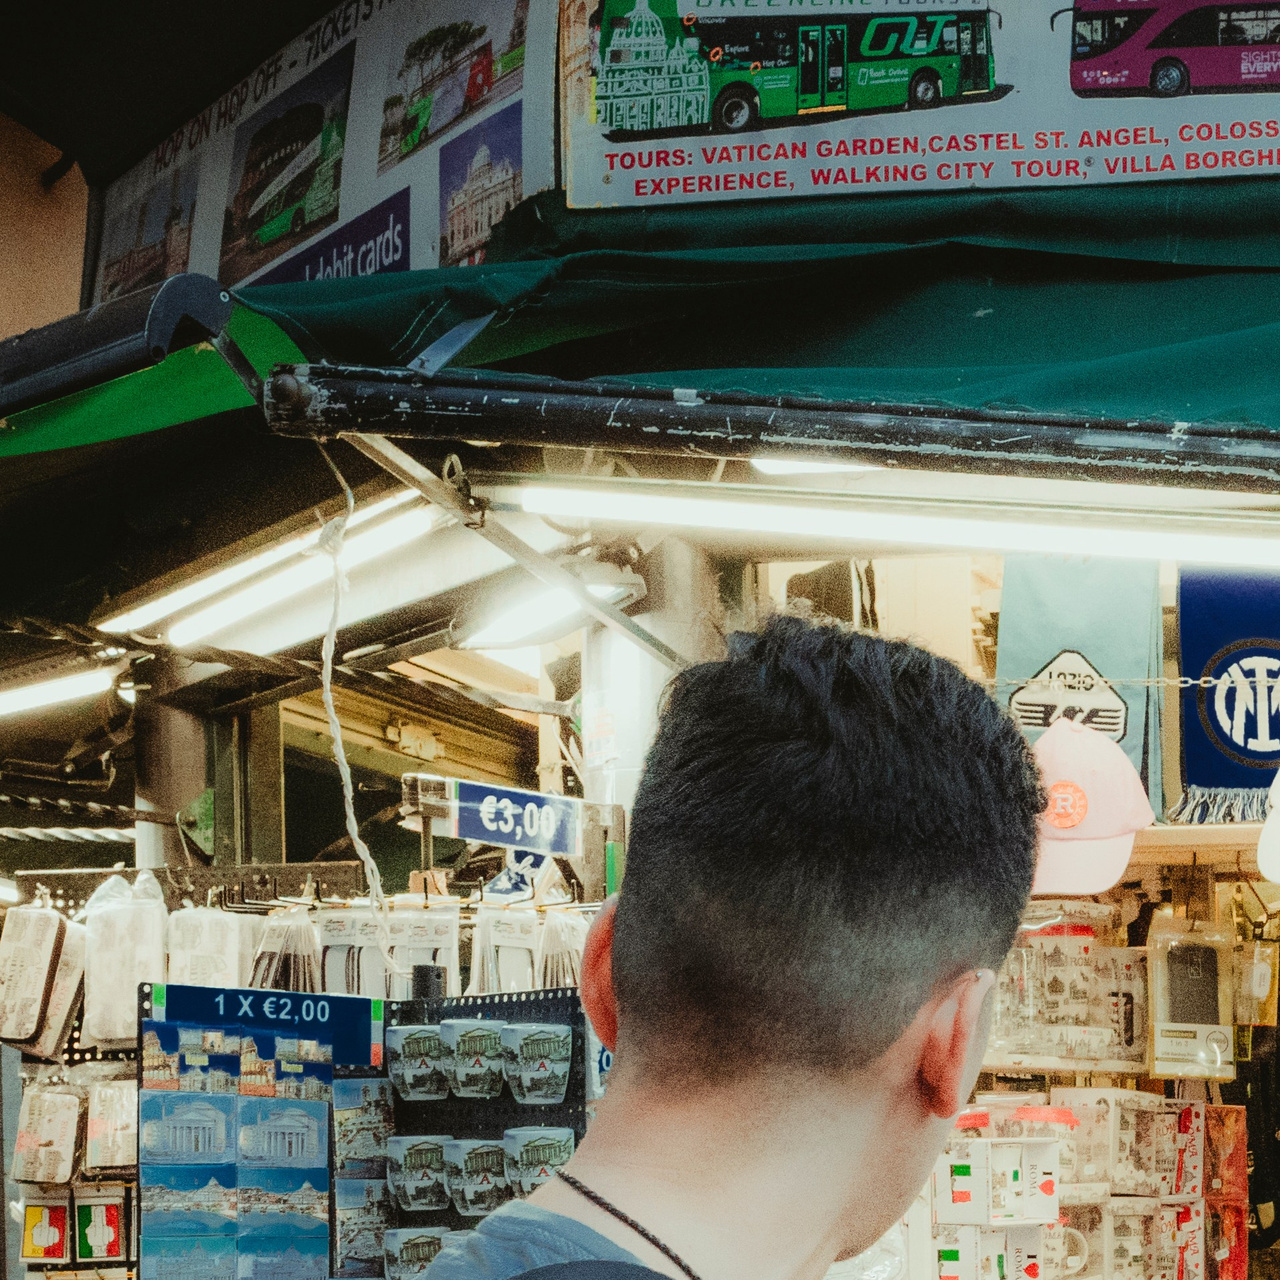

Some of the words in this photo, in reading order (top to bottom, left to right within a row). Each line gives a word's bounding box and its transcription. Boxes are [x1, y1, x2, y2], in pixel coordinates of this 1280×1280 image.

[188, 105, 212, 151] ON
[216, 80, 250, 133] HOP
[254, 54, 283, 103] OFF
[604, 149, 694, 170] TOURS:
[701, 142, 807, 165] VATICAN
[1034, 131, 1069, 151] ST.
[1077, 126, 1170, 150] ANGEL,
[634, 170, 795, 197] EXPERIENCE,
[811, 162, 928, 186] WALKING
[936, 160, 994, 181] CITY
[1011, 158, 1089, 179] TOUR,
[1104, 153, 1176, 176] VILLA
[357, 213, 402, 272] cards
[479, 795, 556, 841] €3,00
[214, 994, 225, 1016] 1
[237, 994, 254, 1018] X
[262, 996, 330, 1025] €2,00
[1029, 1163, 1038, 1199] ROMA
